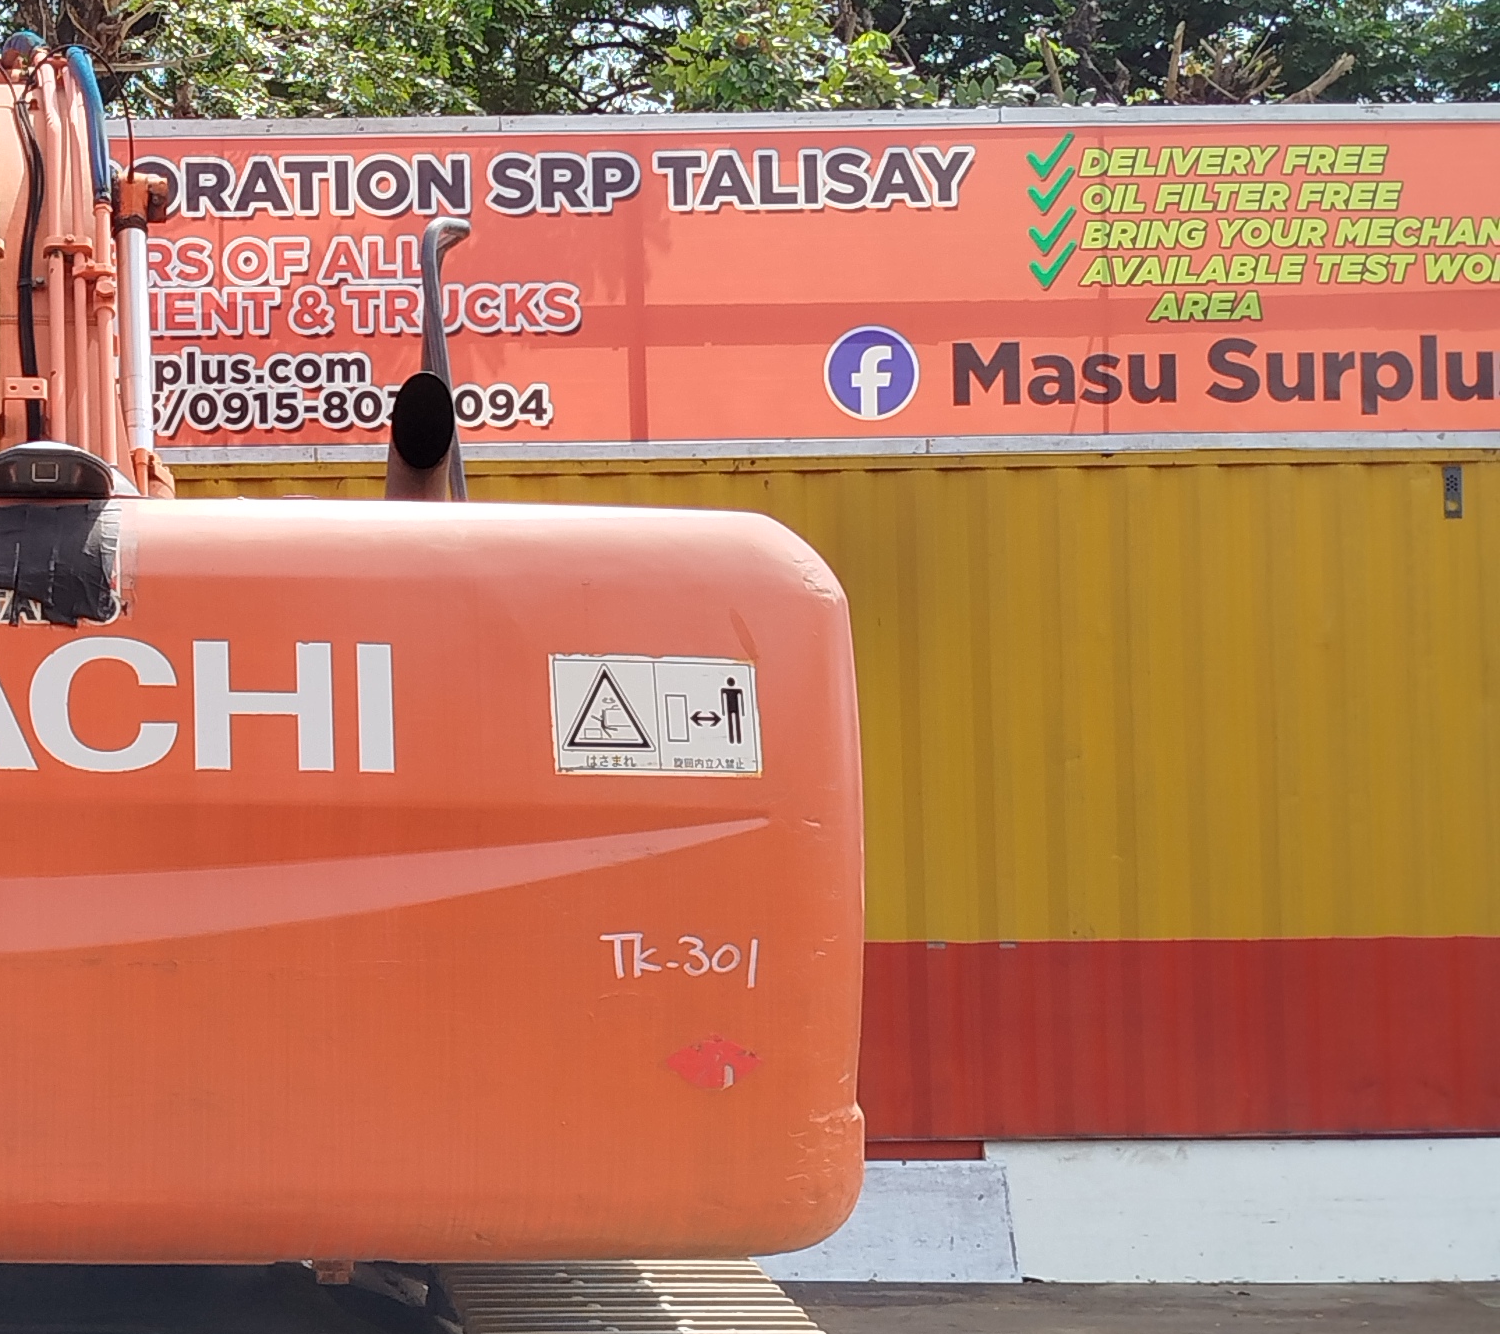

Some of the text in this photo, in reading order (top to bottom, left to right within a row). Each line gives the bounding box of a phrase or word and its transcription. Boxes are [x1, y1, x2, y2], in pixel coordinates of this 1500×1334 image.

[1079, 145, 1388, 178] DELIVERY FREE
[486, 151, 641, 215] SRP
[652, 146, 975, 212] TALISAY
[1081, 181, 1402, 213] OIL FILTER FREE
[1081, 219, 1206, 249] BRING
[1217, 218, 1326, 248] YOUR
[223, 235, 309, 285] OF
[318, 235, 422, 284] ALL
[1079, 254, 1305, 286] AVAILABLE
[1316, 254, 1415, 285] TEST
[288, 284, 334, 335] &
[1147, 291, 1262, 321] AREA
[953, 334, 1500, 416] Masu Surplu
